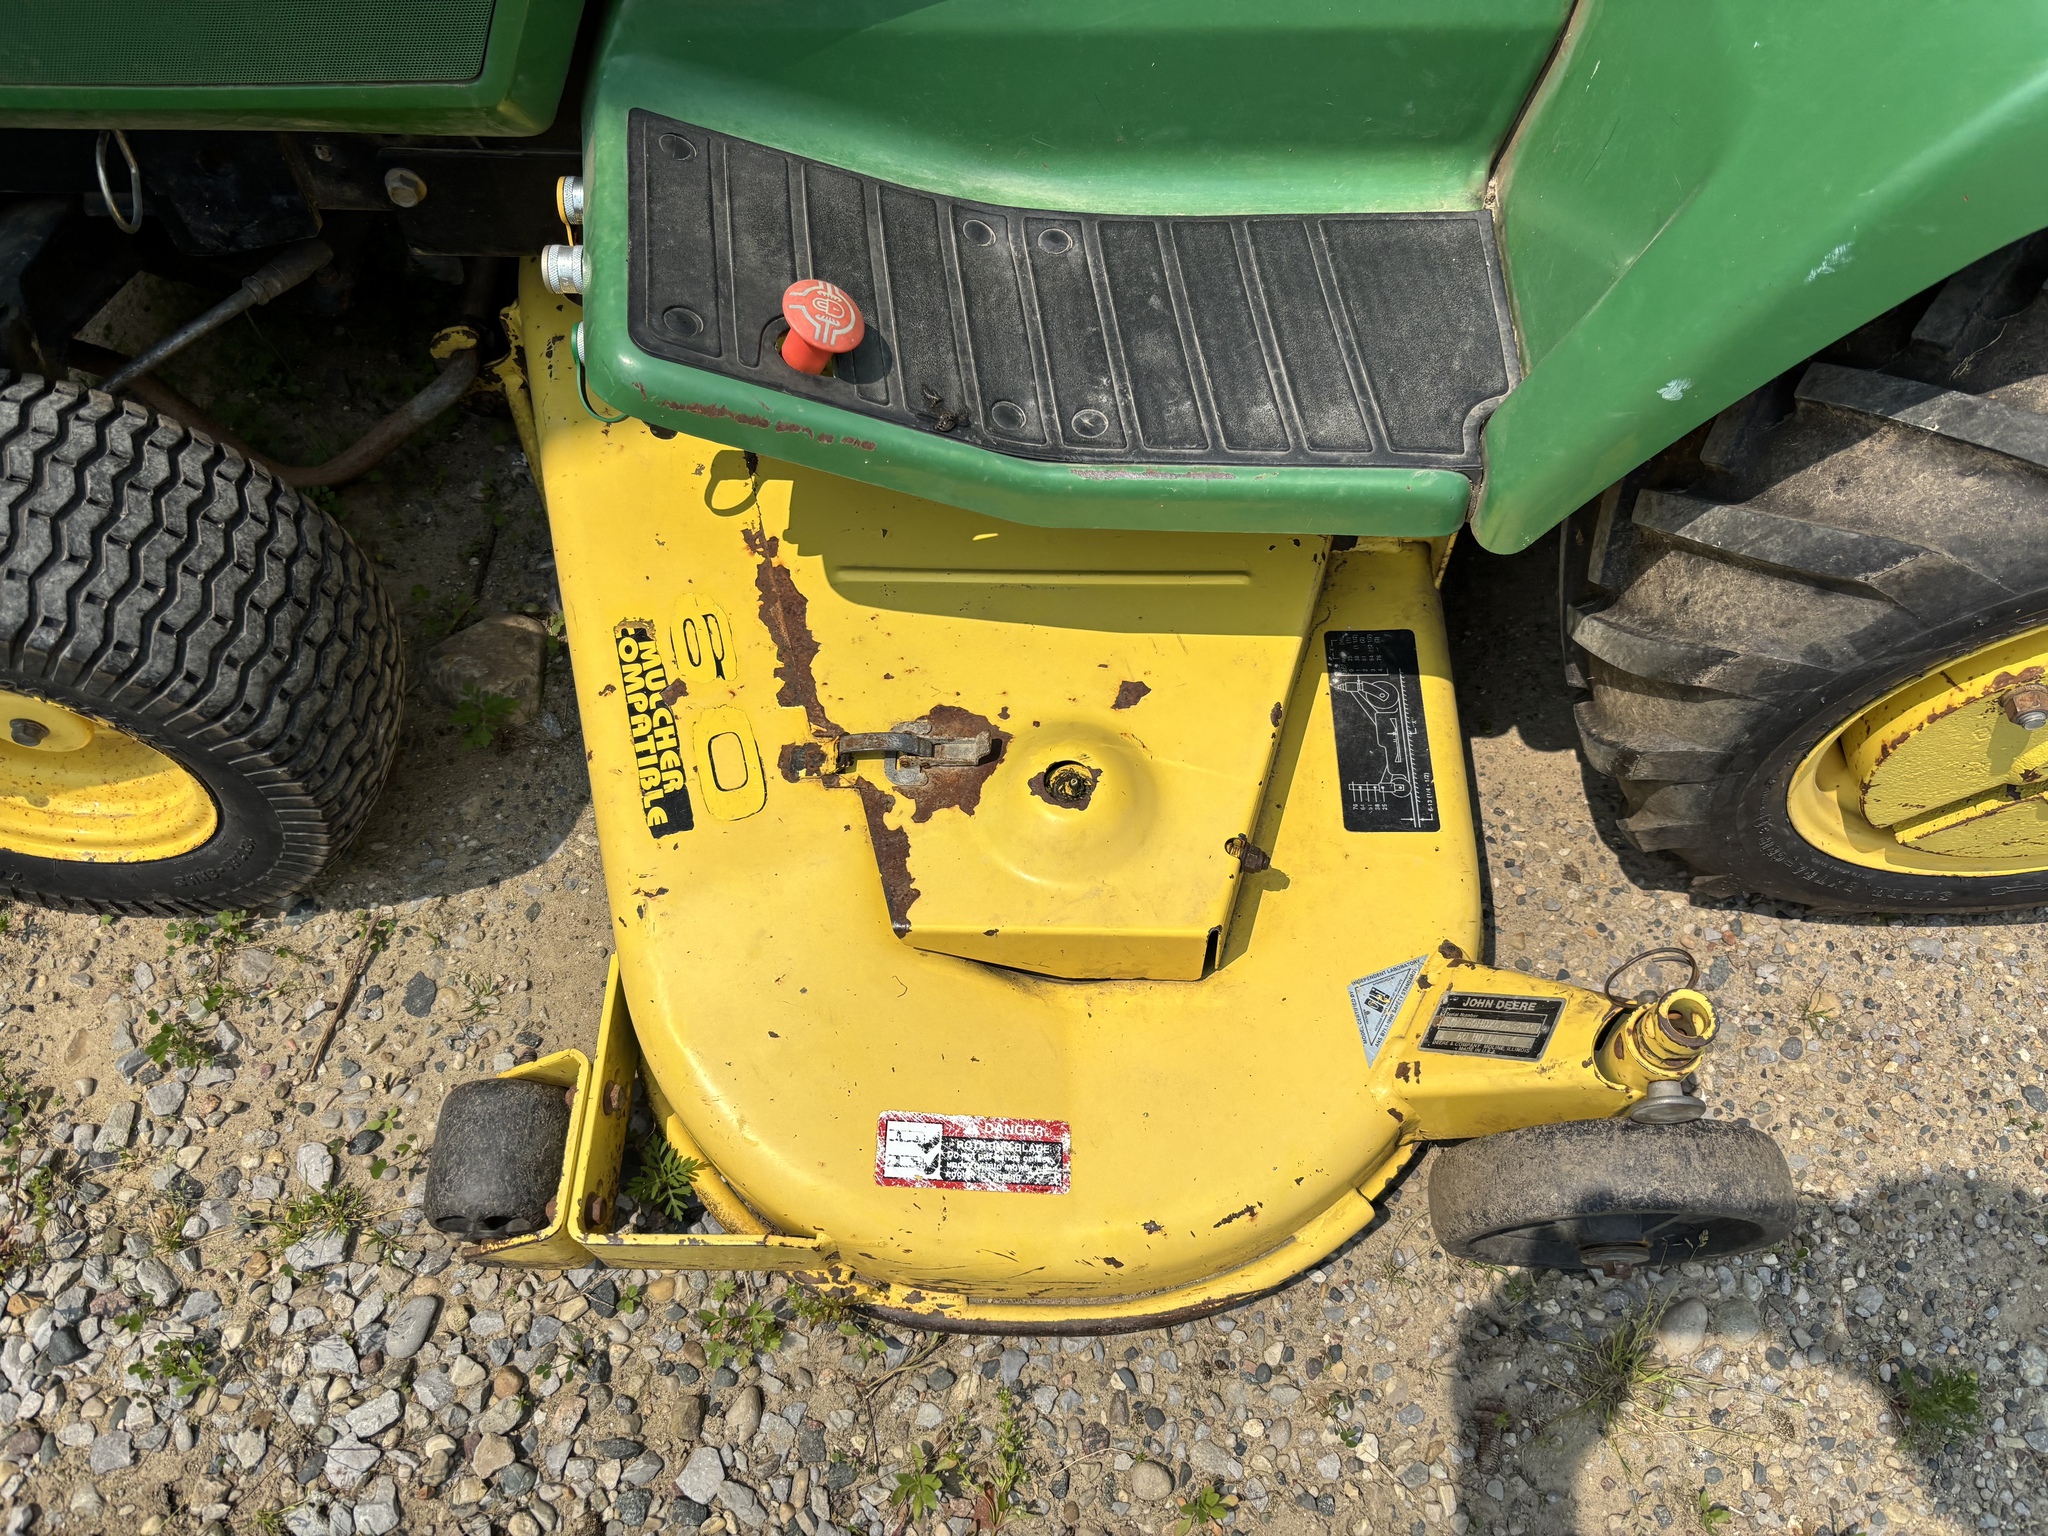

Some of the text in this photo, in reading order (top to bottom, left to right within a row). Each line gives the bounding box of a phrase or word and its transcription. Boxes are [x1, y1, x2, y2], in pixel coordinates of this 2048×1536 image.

[638, 640, 685, 793] MULCHER
[671, 593, 768, 822] 60
[1351, 970, 1386, 986] INDEPENDENT
[1387, 958, 1420, 974] LABORATORY
[1375, 1037, 1383, 1048] ANS
[1393, 994, 1404, 1013] SAFETY
[1401, 970, 1416, 995] STANDARD
[1462, 997, 1537, 1011] JOHN DEERE
[1359, 1026, 1368, 1044] MODEL
[985, 1123, 1044, 1136] DANGER
